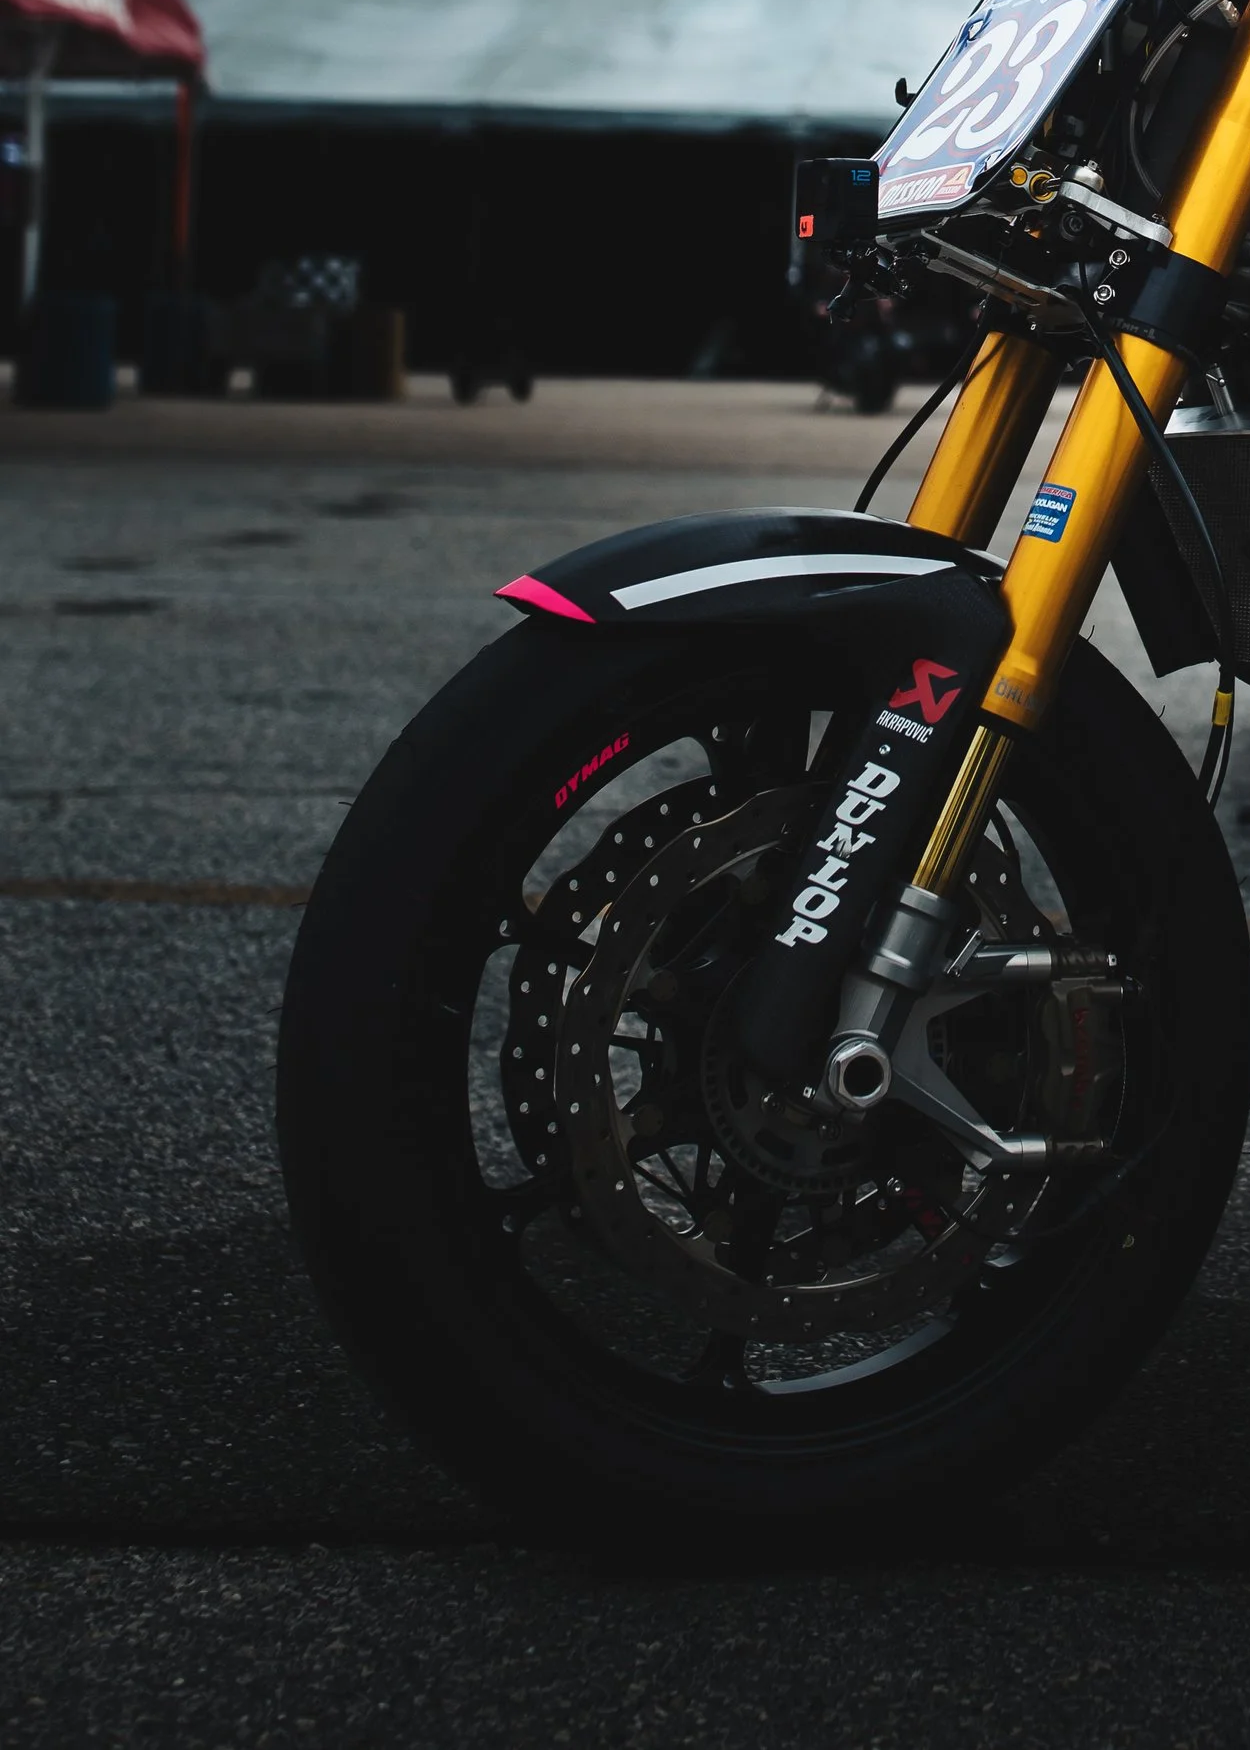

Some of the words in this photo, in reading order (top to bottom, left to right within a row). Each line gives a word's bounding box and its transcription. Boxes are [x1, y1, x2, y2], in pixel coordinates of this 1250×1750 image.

[851, 169, 871, 181] 12
[553, 731, 631, 810] DYMAG
[774, 761, 902, 948] DUNLOP
